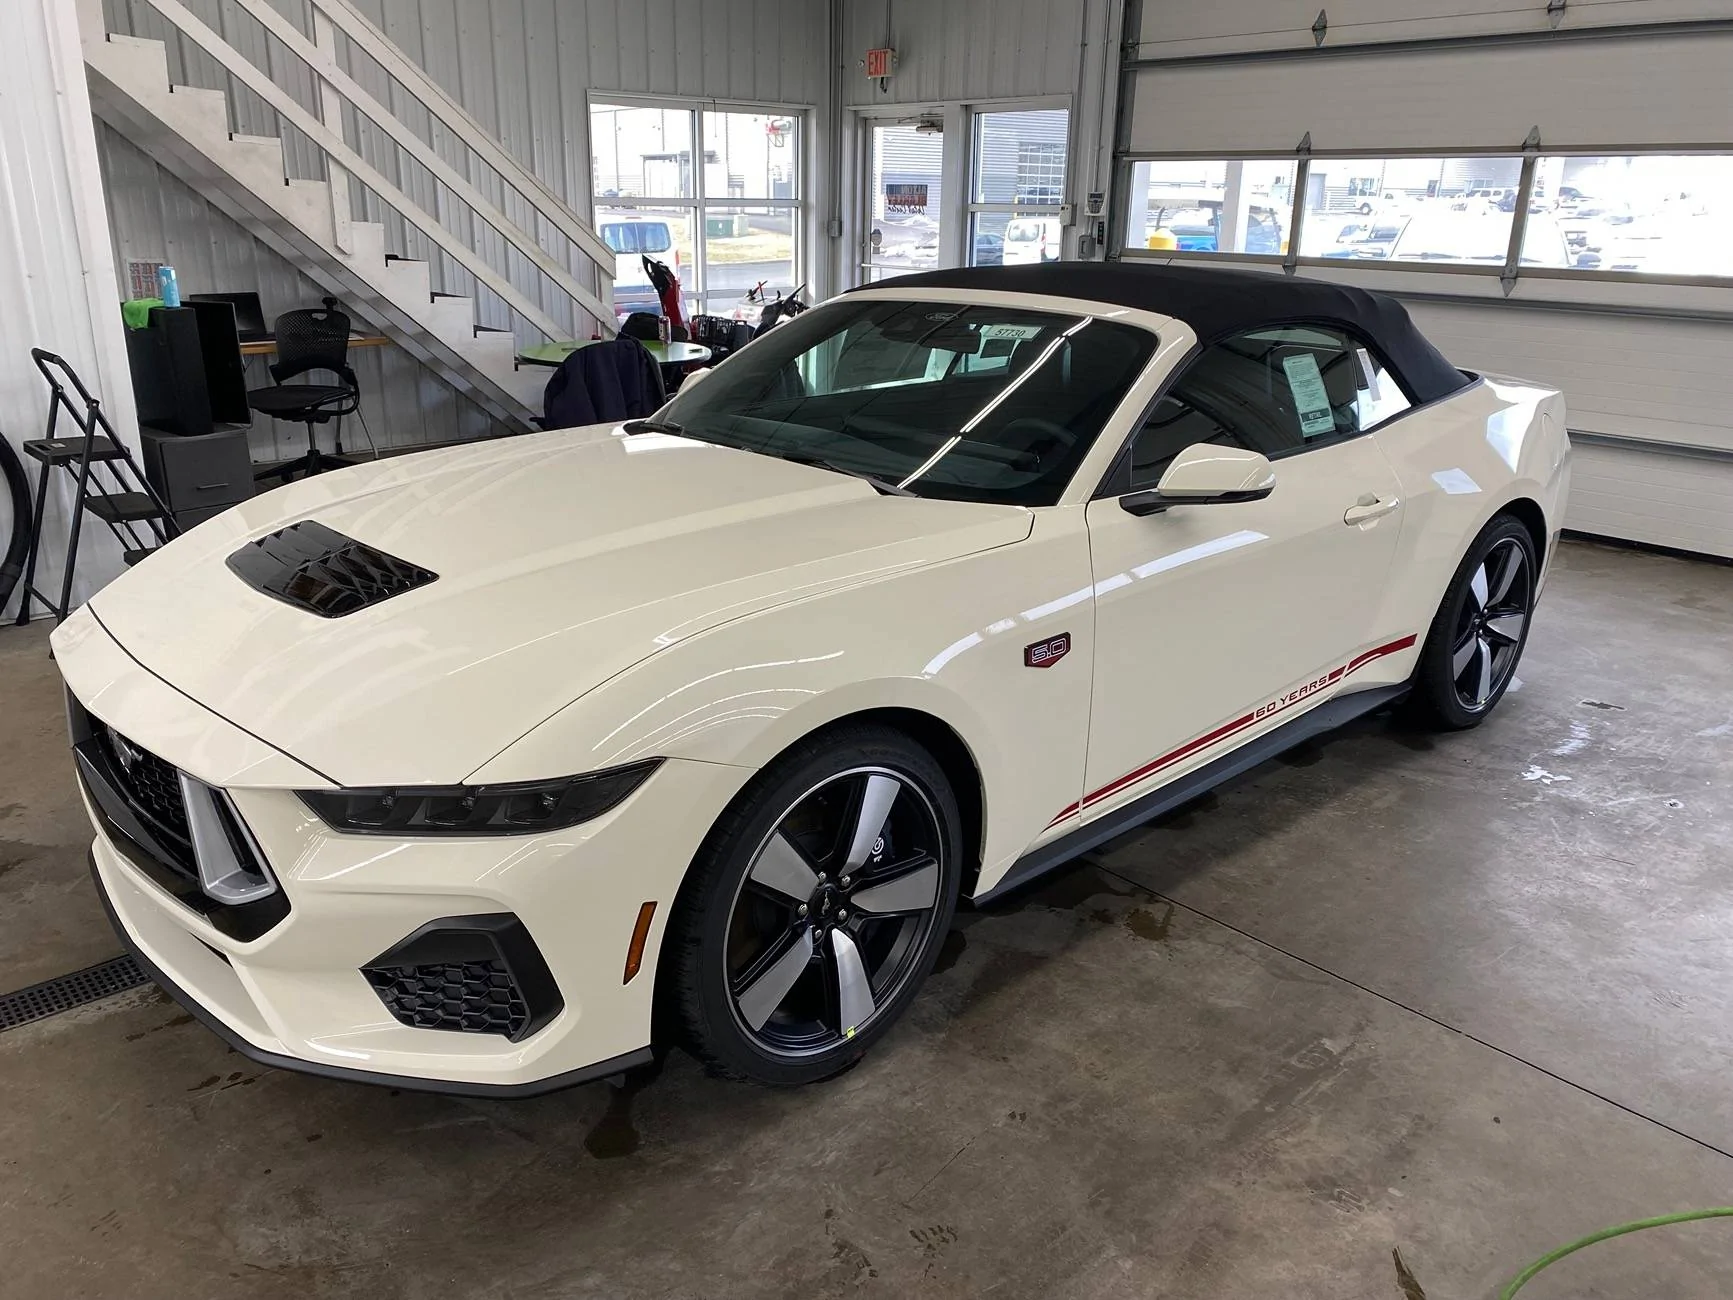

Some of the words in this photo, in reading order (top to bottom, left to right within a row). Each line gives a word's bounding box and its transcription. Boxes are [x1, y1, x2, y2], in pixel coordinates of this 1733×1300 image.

[868, 51, 887, 75] EXIT
[995, 328, 1026, 337] 57730
[1031, 637, 1067, 664] 5.0
[1256, 701, 1276, 718] 60
[1280, 676, 1327, 705] YEARS
